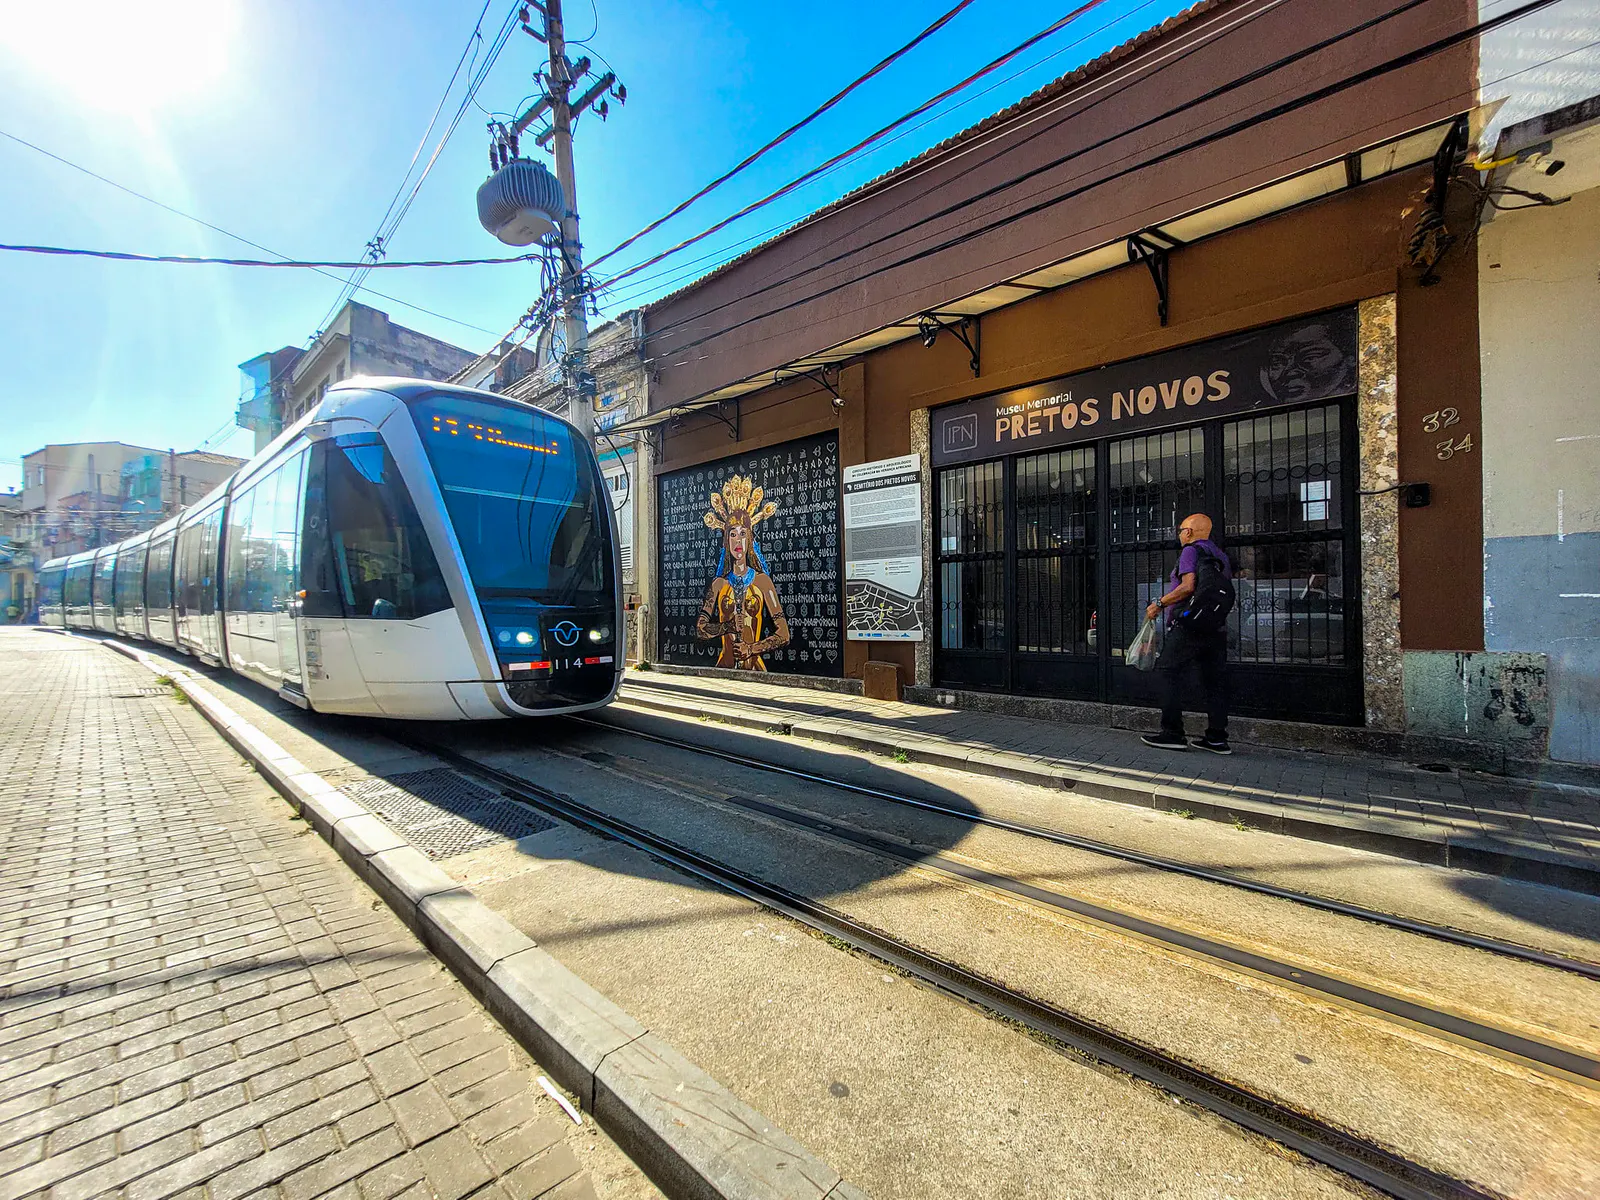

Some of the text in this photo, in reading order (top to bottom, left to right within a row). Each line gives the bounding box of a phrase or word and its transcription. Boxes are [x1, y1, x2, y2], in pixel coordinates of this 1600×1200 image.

[995, 370, 1231, 443] PRETOS NOVOS
[996, 391, 1073, 417] Museu Memorial
[1422, 407, 1460, 433] 32
[948, 423, 973, 444] IPN
[1436, 433, 1474, 461] 34
[763, 455, 836, 478] ANTEPASSADOS
[854, 474, 917, 490] CEMITÉRIO DOS PRETOS NOVOS
[791, 523, 837, 537] PROTETORAS
[555, 658, 583, 669] 114
